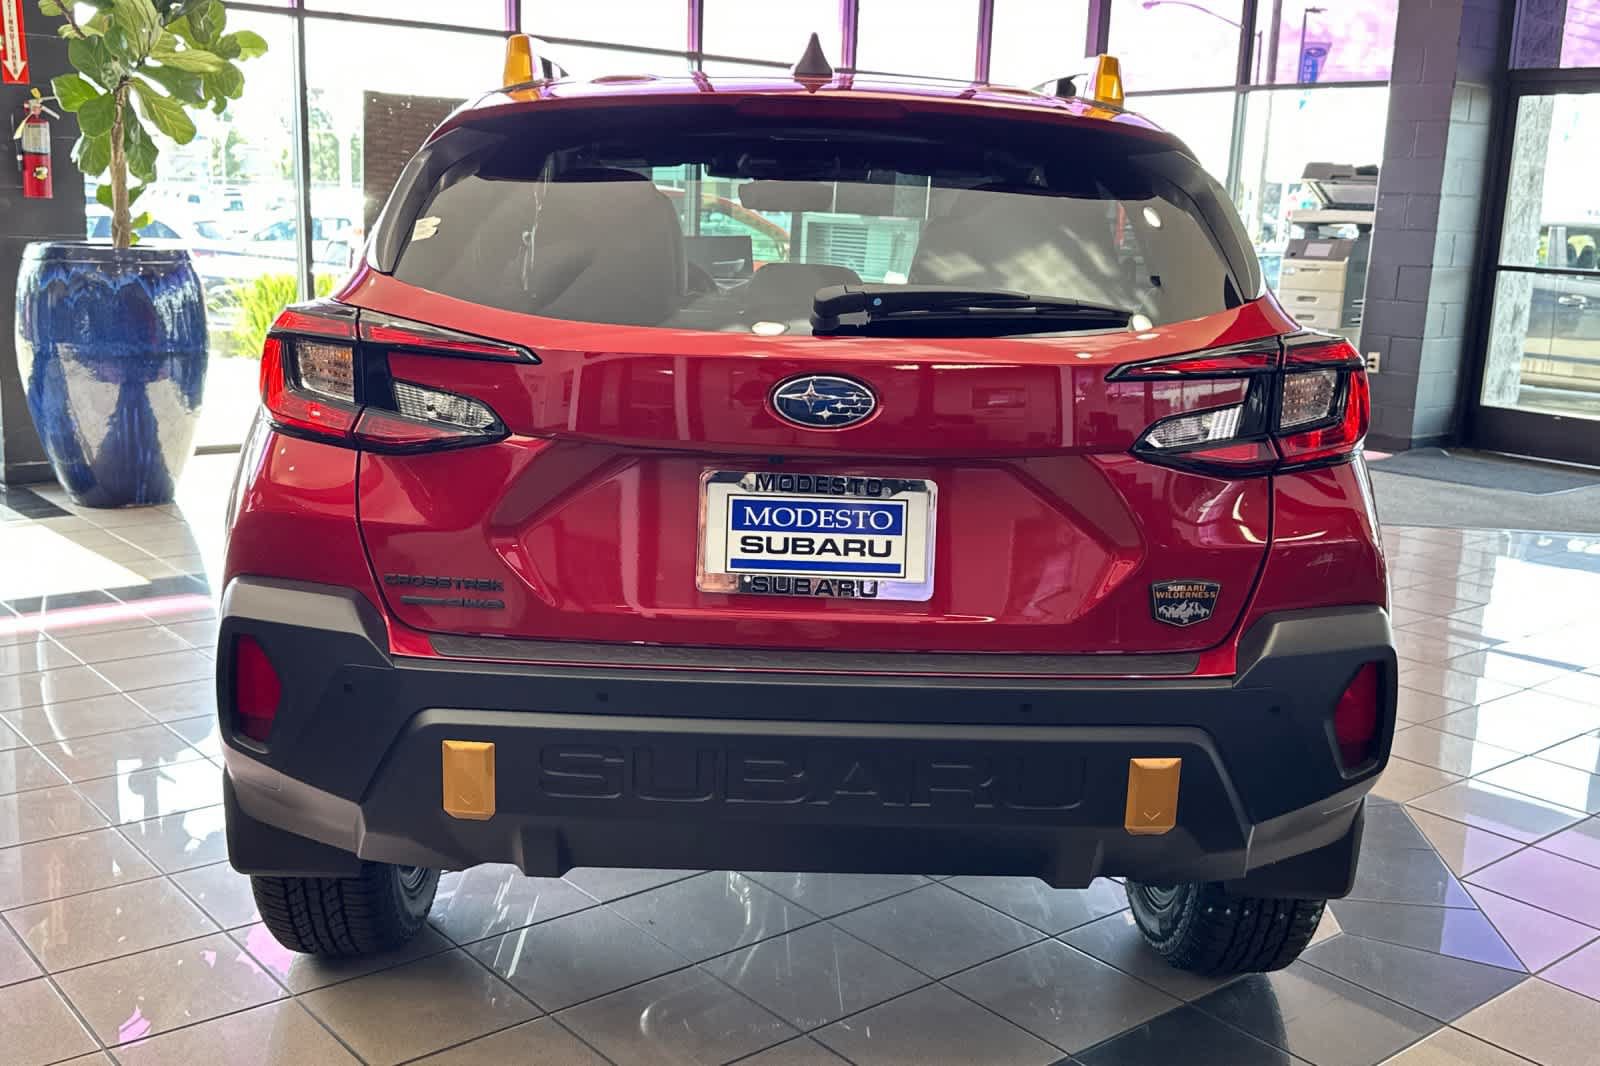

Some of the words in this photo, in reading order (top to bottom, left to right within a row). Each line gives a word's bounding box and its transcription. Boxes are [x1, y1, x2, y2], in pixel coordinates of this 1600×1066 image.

[756, 473, 882, 497] MODESTO
[744, 506, 894, 530] MODESTO
[740, 535, 892, 557] SUBARU
[384, 573, 505, 592] CROSSTREK
[752, 577, 878, 598] SUBARU
[1167, 584, 1206, 592] SUBARU
[1156, 591, 1217, 600] WILDERNESS
[540, 743, 1084, 810] SUBARU
